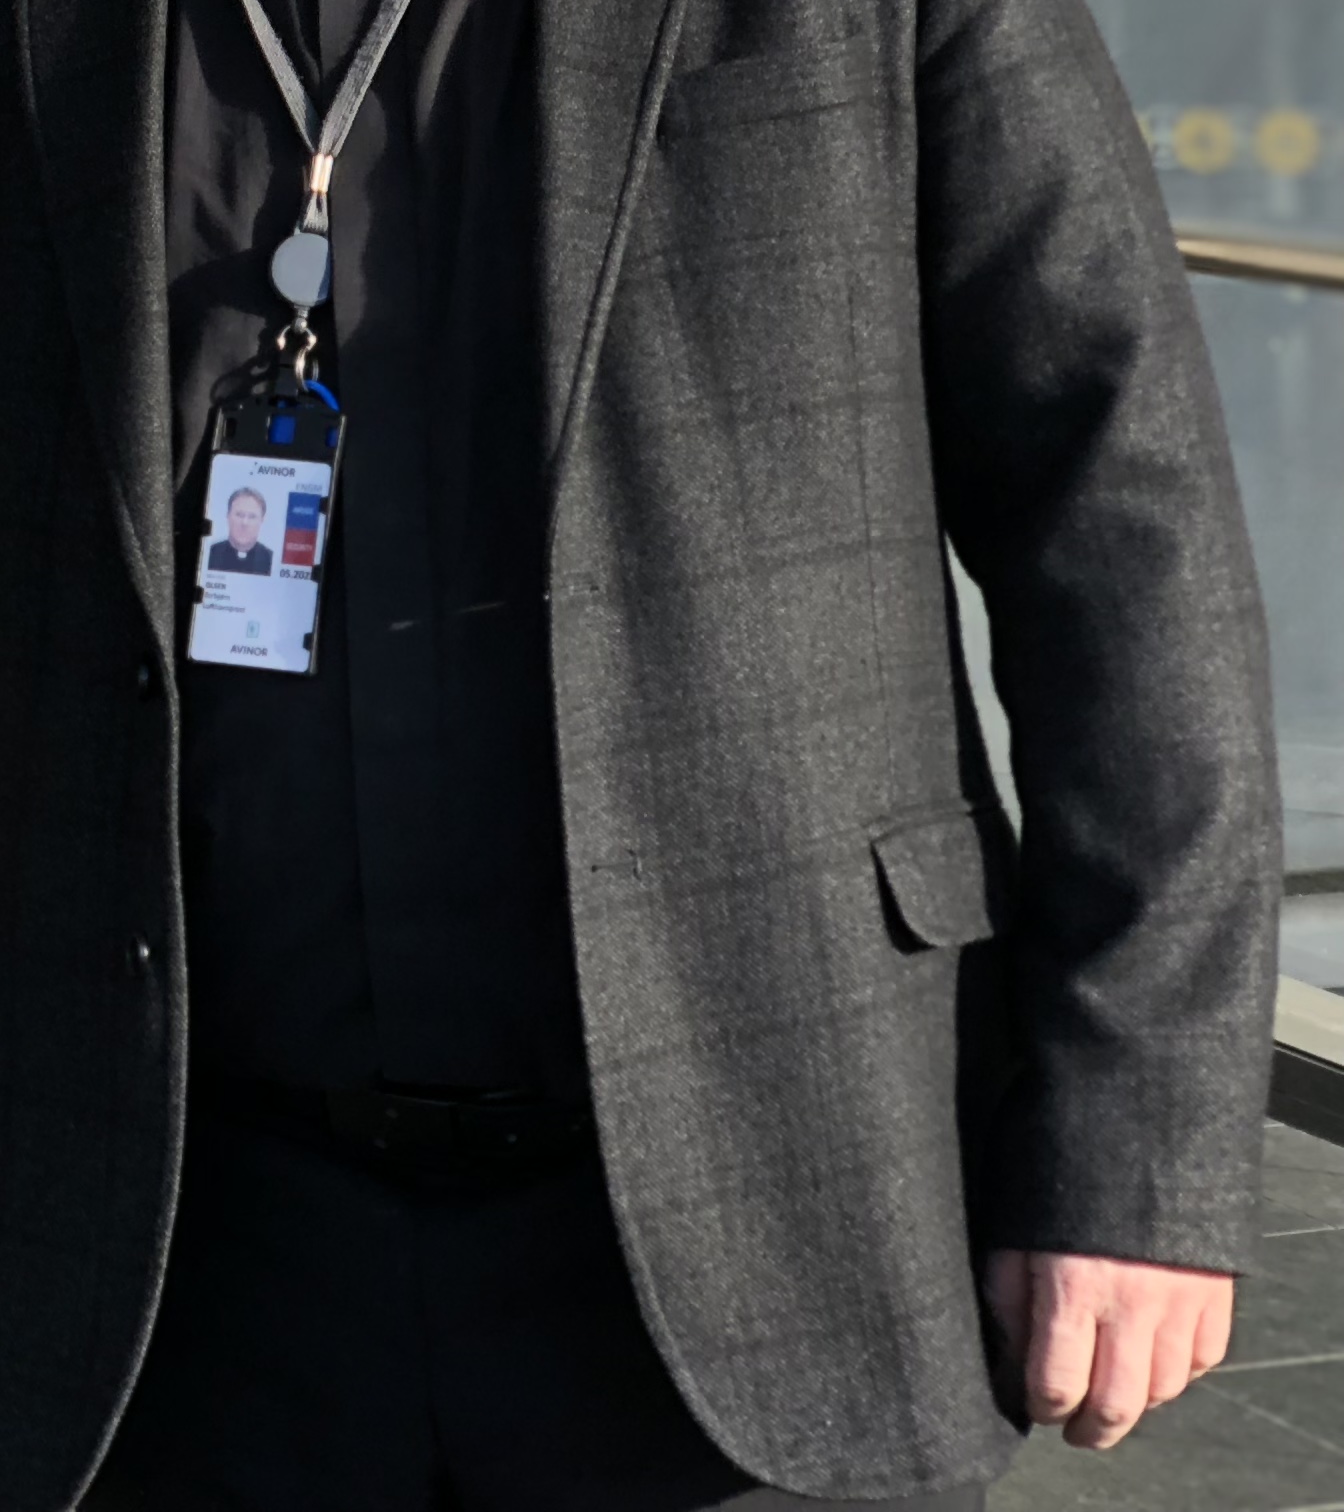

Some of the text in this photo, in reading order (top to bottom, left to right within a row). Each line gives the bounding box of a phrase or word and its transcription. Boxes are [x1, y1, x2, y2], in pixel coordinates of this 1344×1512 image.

[257, 465, 296, 477] AVINOR
[279, 569, 312, 580] 05.202
[230, 644, 269, 656] AVINOR
